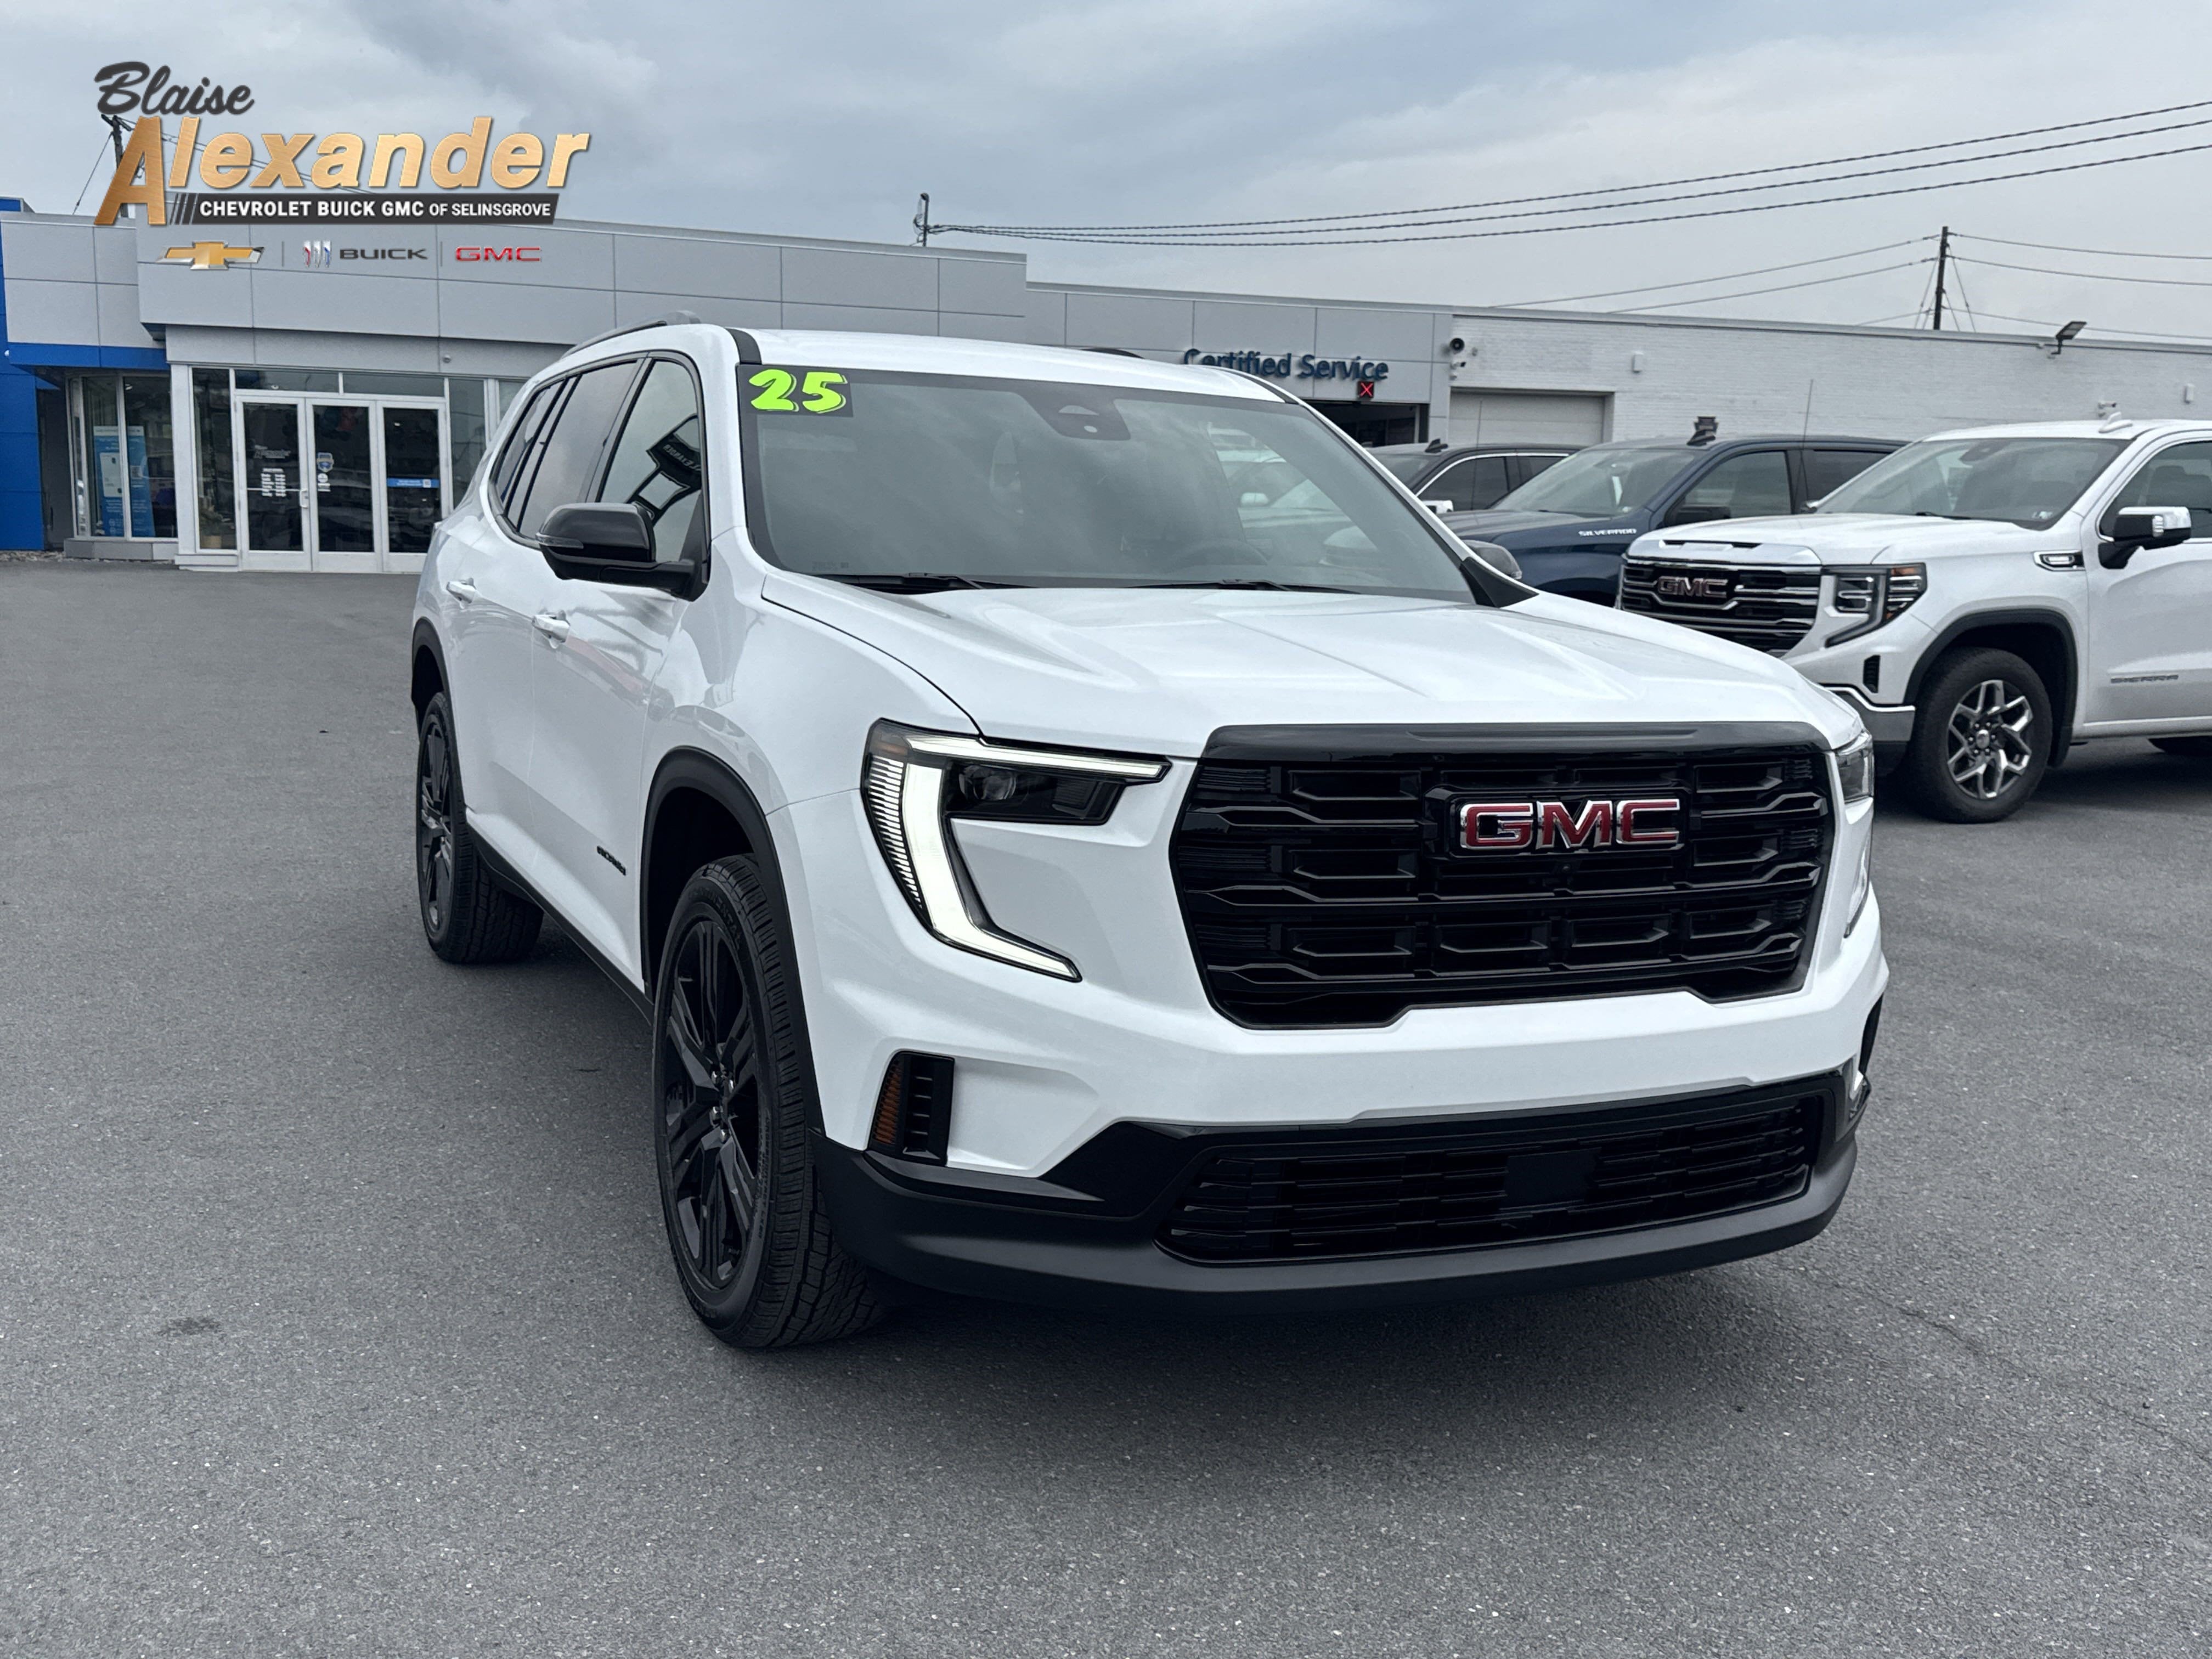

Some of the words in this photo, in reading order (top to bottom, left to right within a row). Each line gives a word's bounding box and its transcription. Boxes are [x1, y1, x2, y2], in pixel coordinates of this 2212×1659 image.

[1300, 354, 1389, 380] Service
[749, 369, 848, 414] 25
[1657, 575, 1728, 599] GMC
[1460, 799, 1680, 849] GMC
